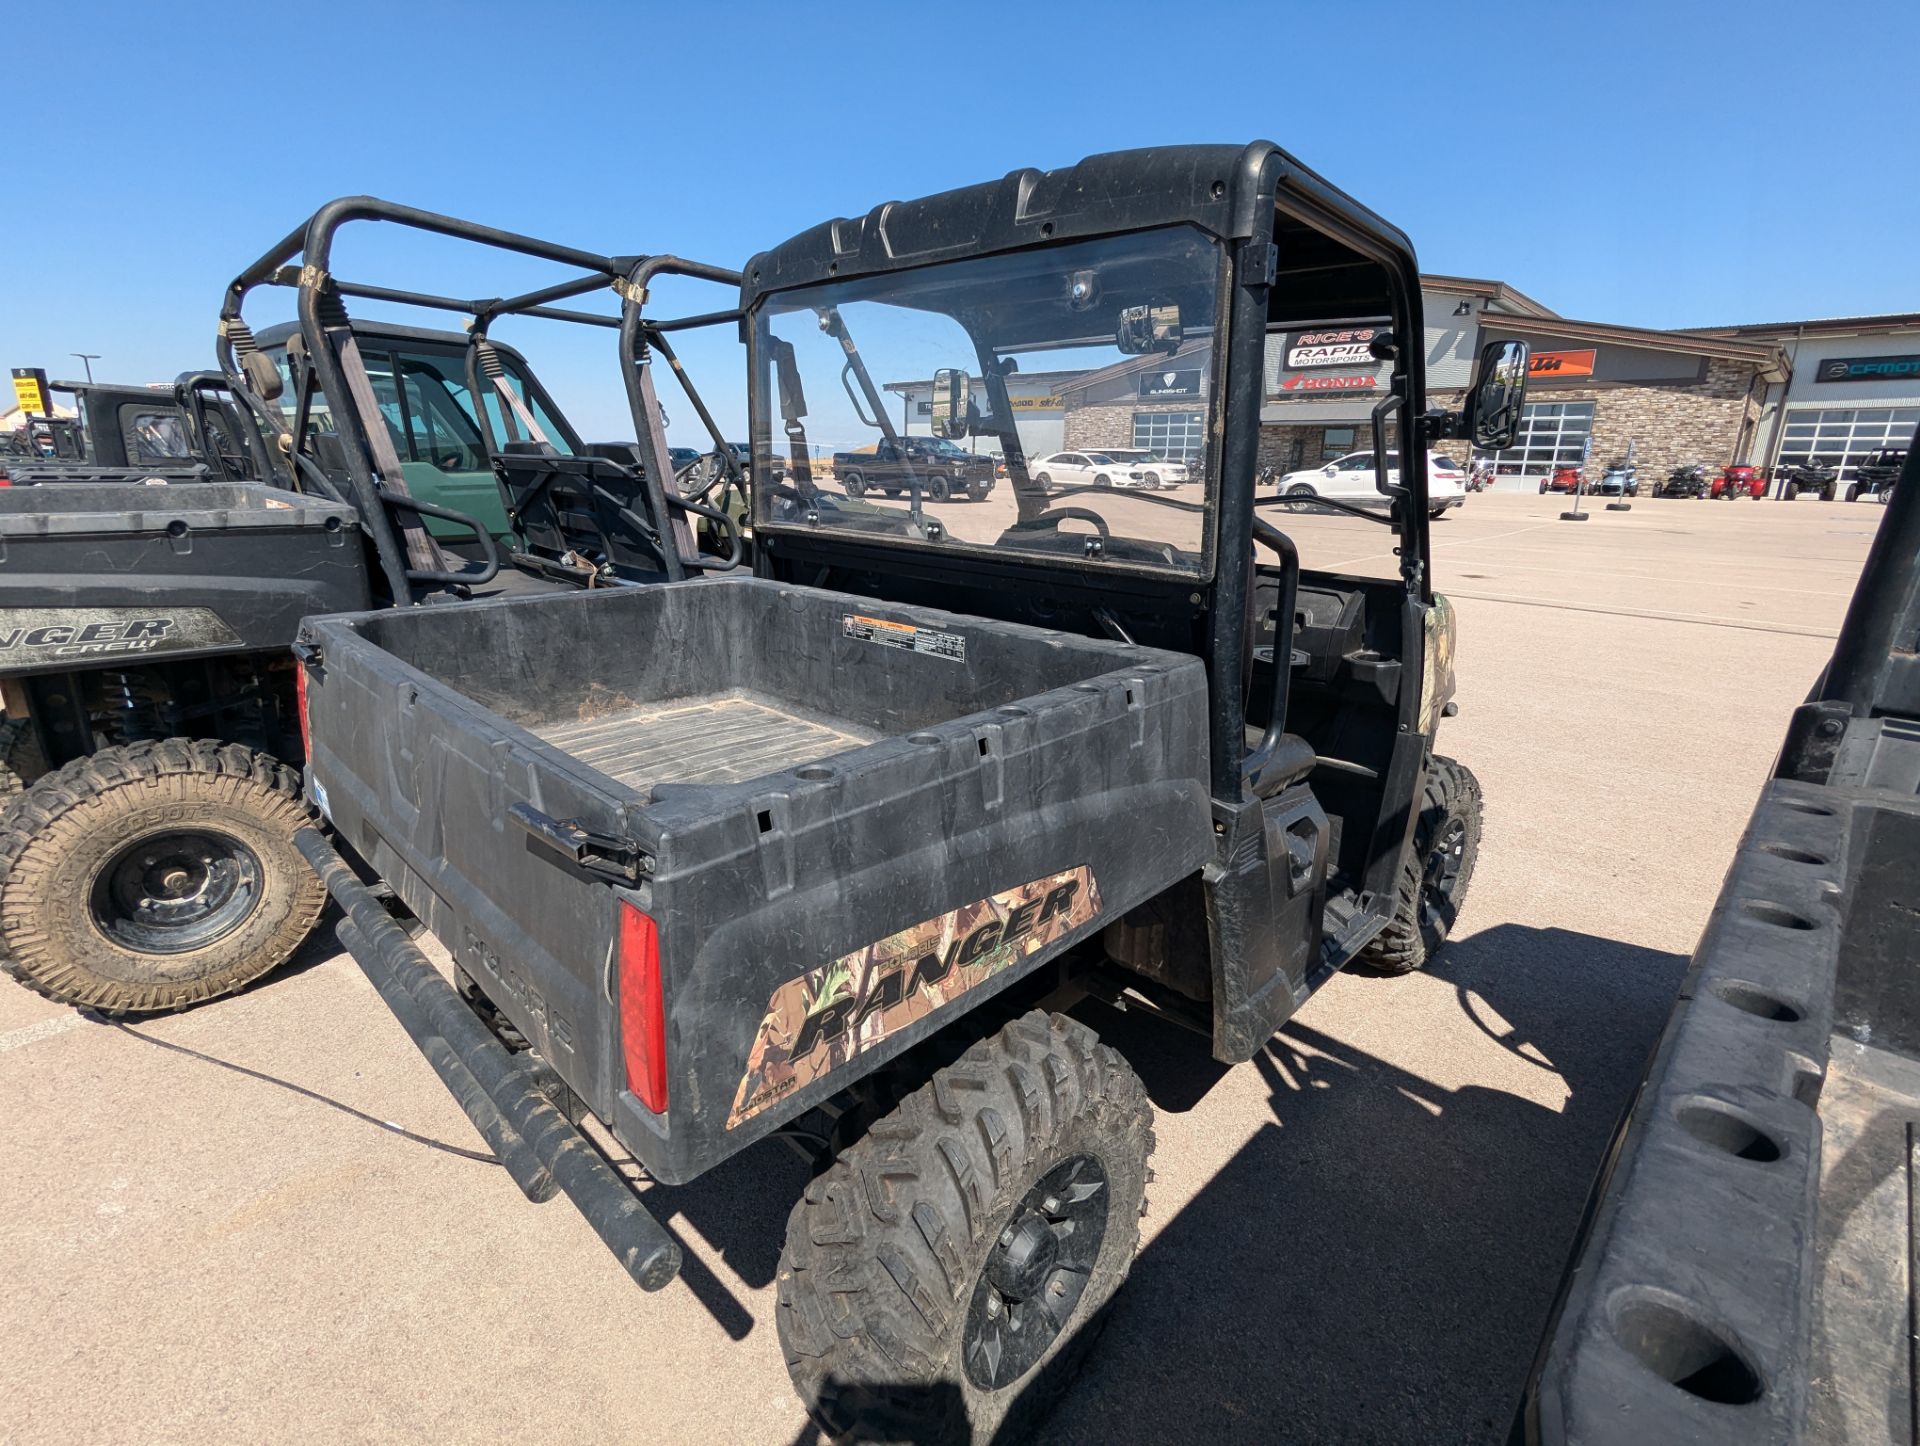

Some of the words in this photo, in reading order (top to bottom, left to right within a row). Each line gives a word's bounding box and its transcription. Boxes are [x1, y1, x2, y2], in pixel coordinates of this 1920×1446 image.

[1297, 329, 1375, 346] RICE'S
[1295, 344, 1370, 358] RAPID
[1294, 354, 1371, 366] MOTORSPORTS
[1303, 375, 1378, 390] HONDA
[1149, 387, 1188, 395] SLINGSHOT
[877, 934, 942, 978] POLARIS
[786, 879, 1080, 1064] RANGER
